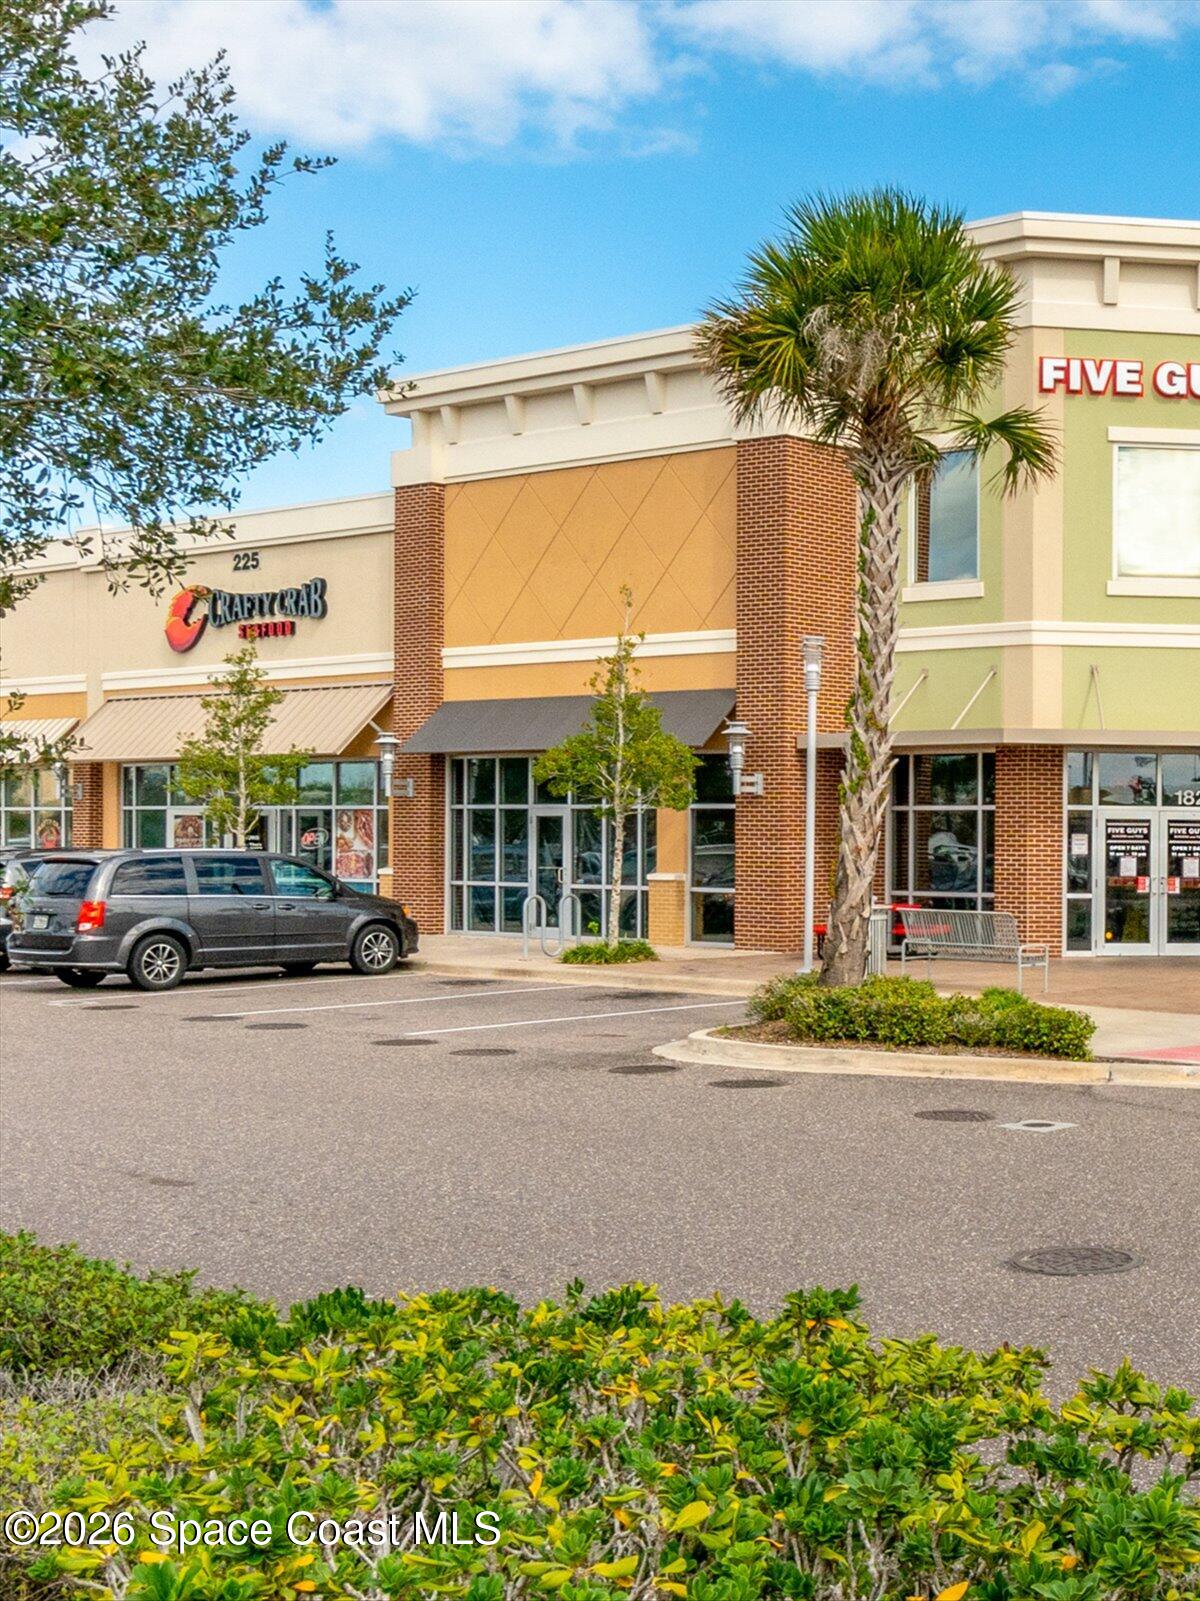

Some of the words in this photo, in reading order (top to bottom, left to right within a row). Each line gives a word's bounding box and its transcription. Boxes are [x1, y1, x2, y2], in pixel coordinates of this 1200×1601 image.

[1039, 356, 1143, 397] FIVE
[233, 552, 259, 571] 225
[209, 588, 275, 628] CRAFTY
[276, 577, 328, 619] CRAB
